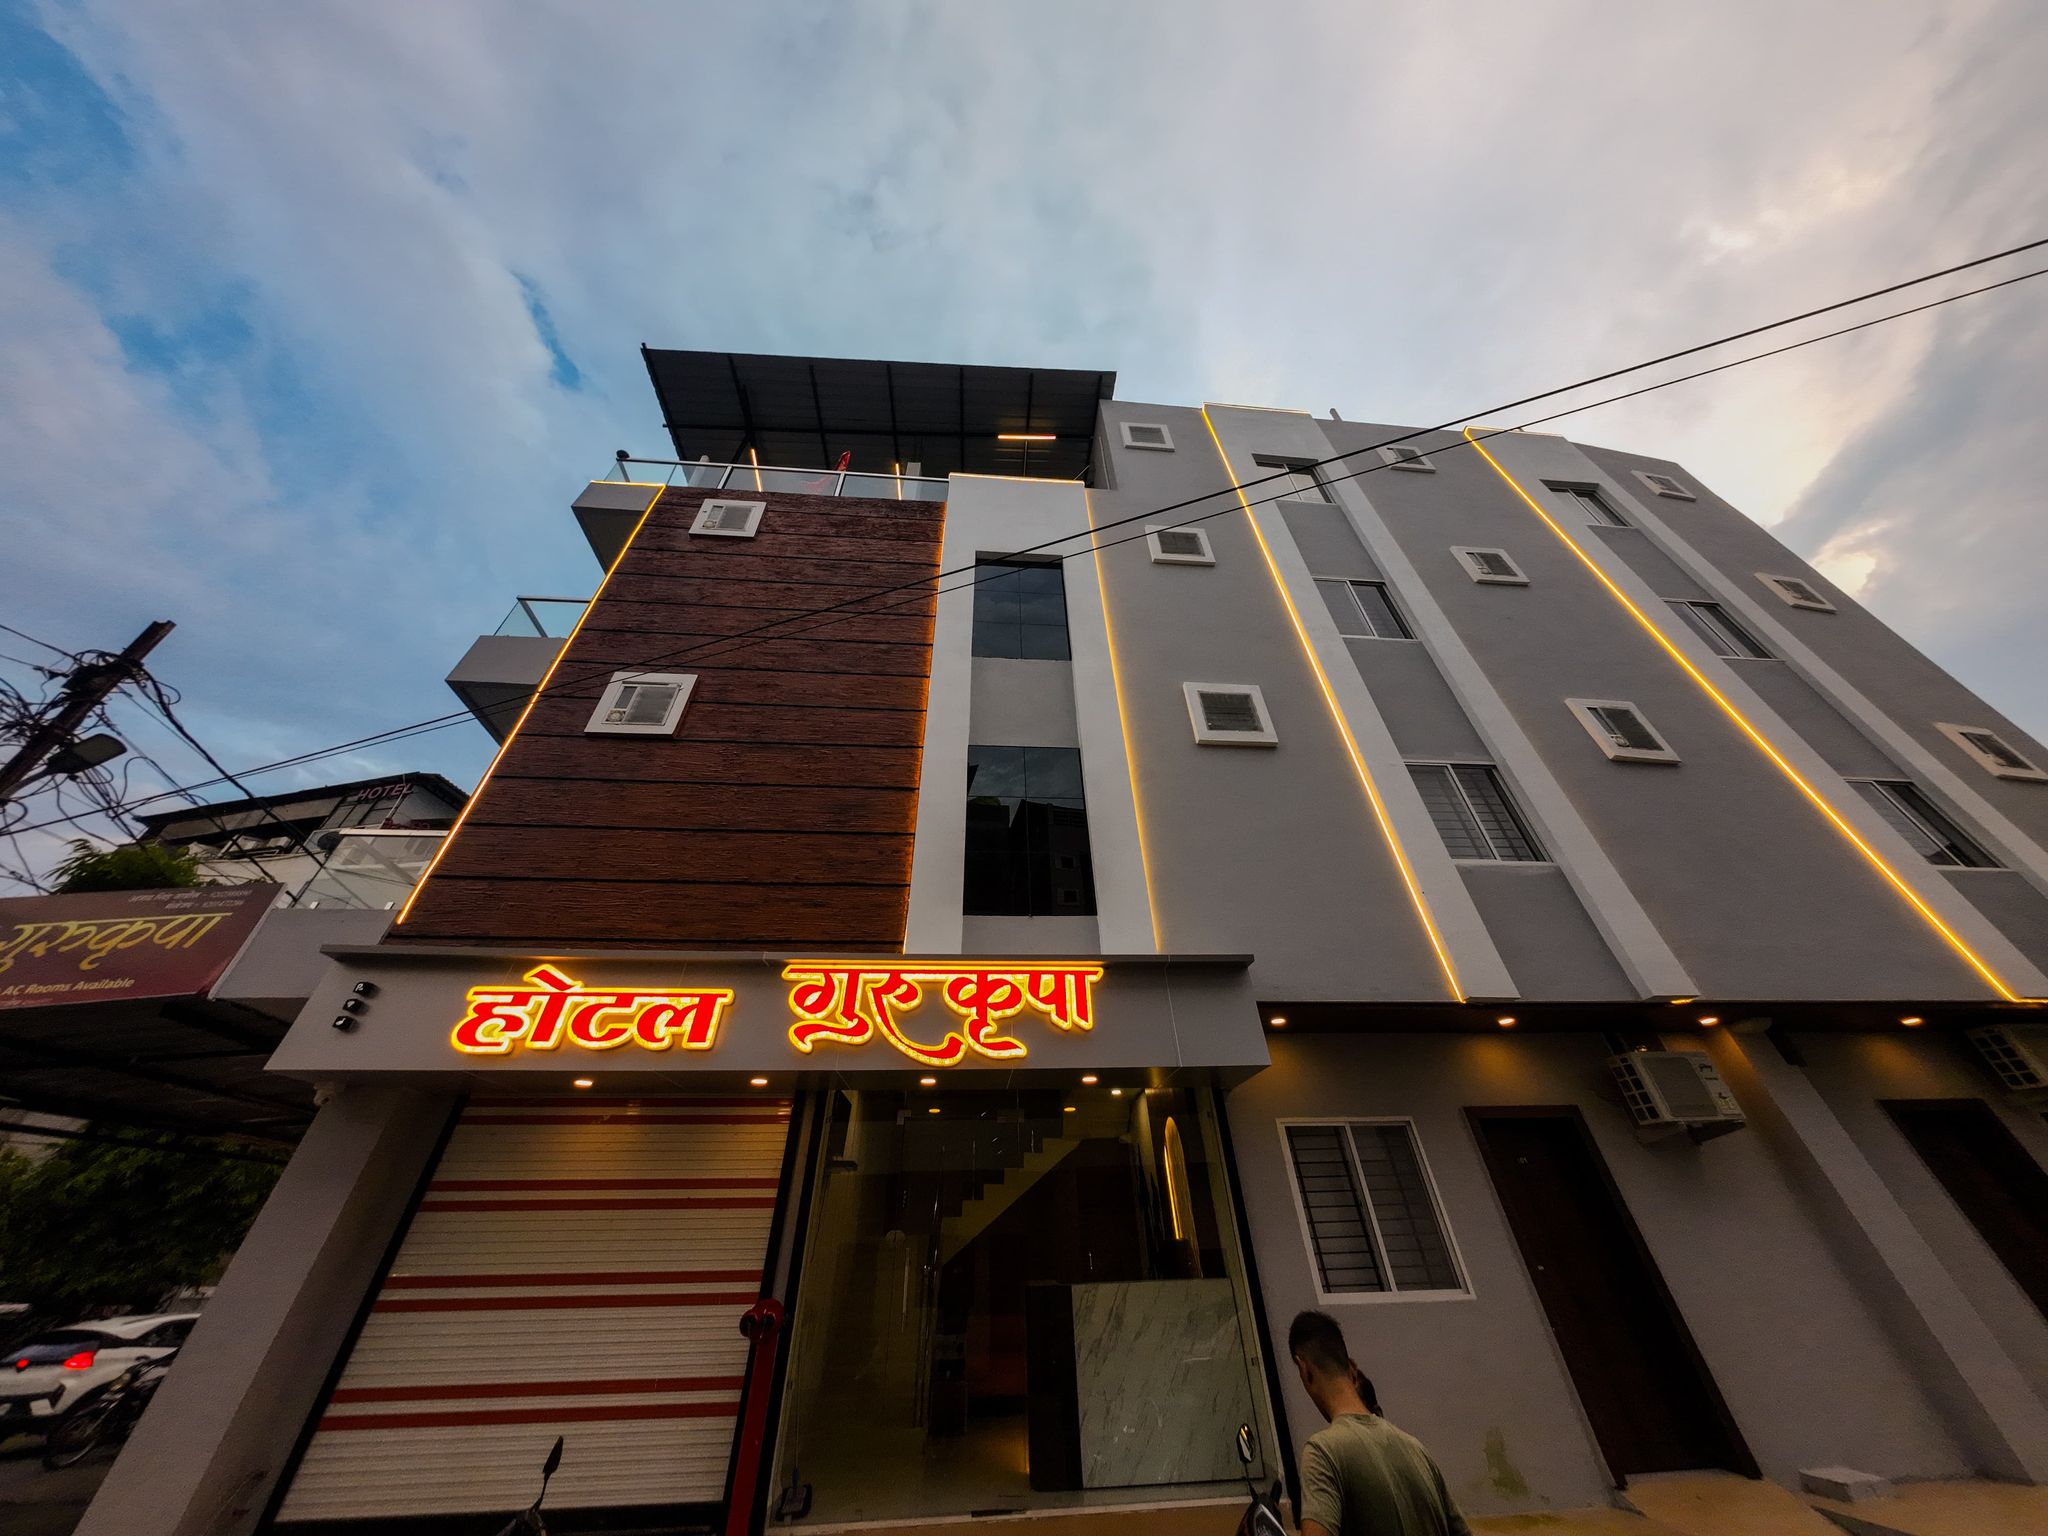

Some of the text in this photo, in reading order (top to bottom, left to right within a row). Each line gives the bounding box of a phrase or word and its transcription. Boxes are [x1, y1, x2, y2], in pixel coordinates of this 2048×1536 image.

[354, 783, 414, 800] HOTEL
[0, 977, 135, 996] AC Rooms Available
[451, 963, 734, 1054] होटल
